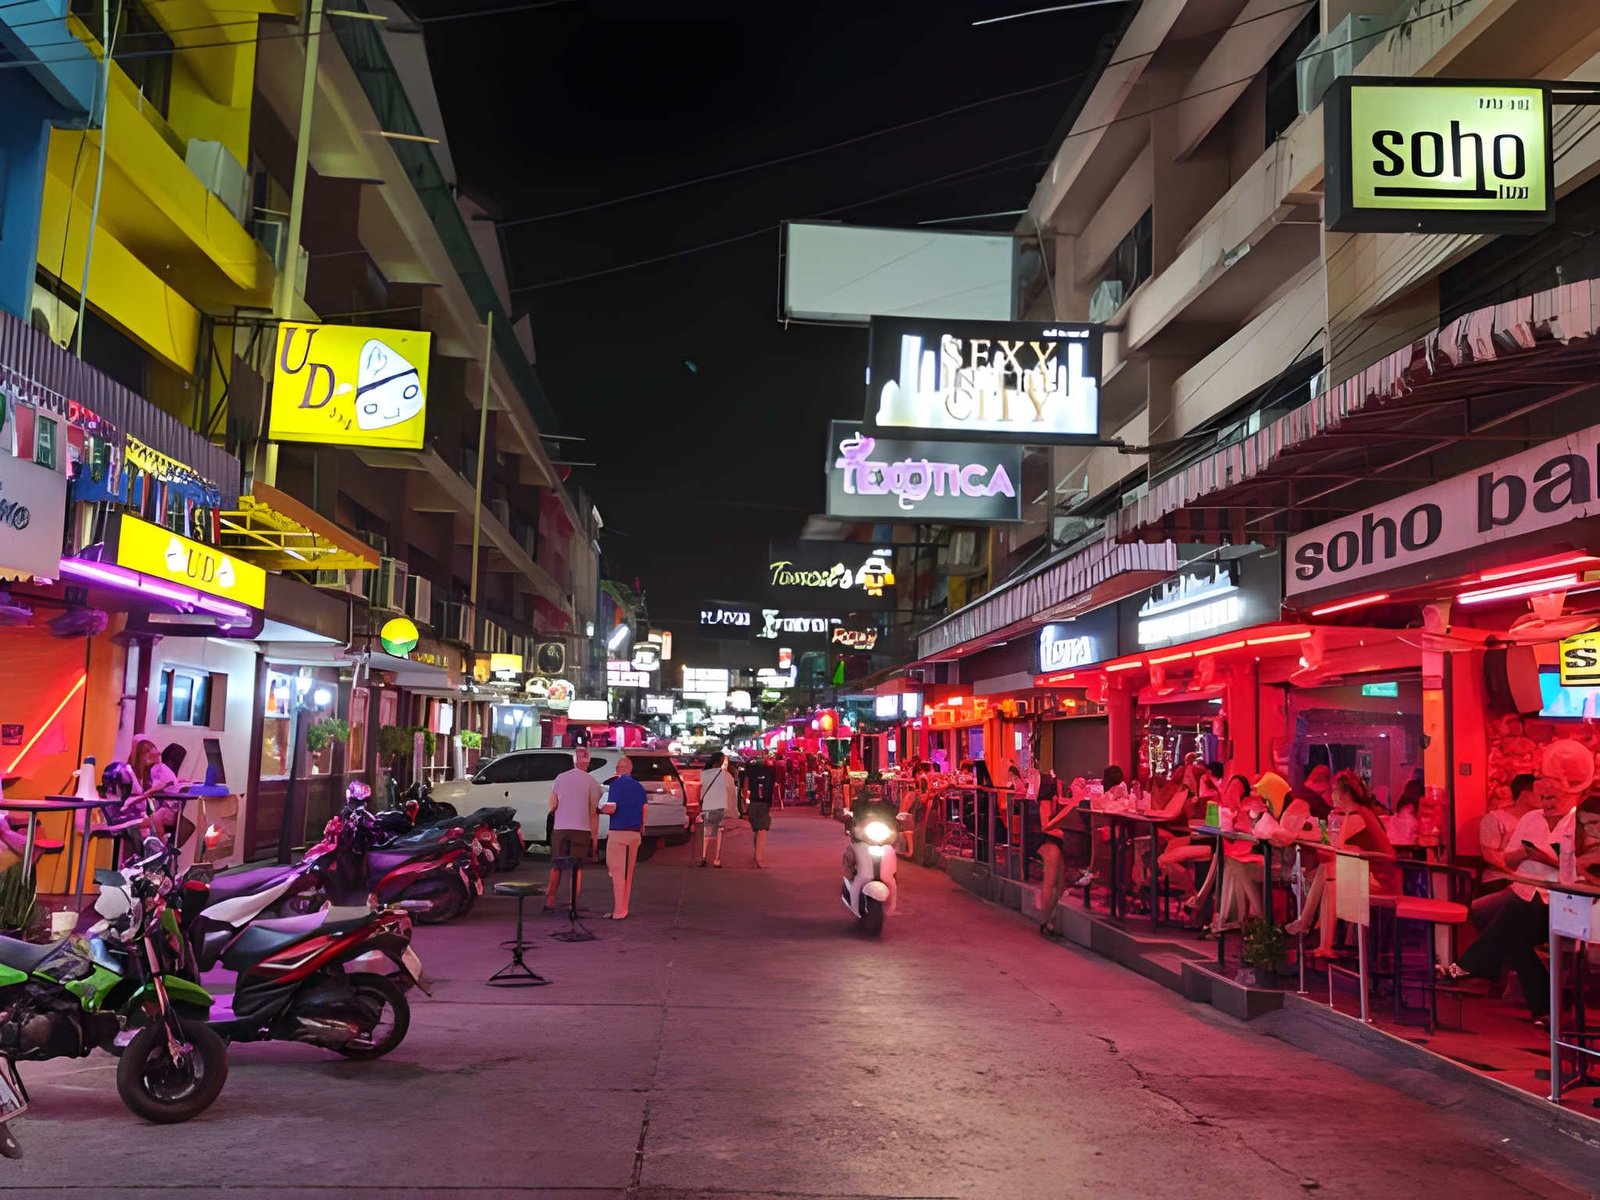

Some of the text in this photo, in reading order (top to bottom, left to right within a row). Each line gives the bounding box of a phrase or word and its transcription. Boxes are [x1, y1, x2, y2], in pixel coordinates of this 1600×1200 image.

[1371, 119, 1526, 191] soho
[942, 337, 1057, 372] SEXY
[1294, 442, 1600, 581] soho ba
[186, 548, 215, 583] UD
